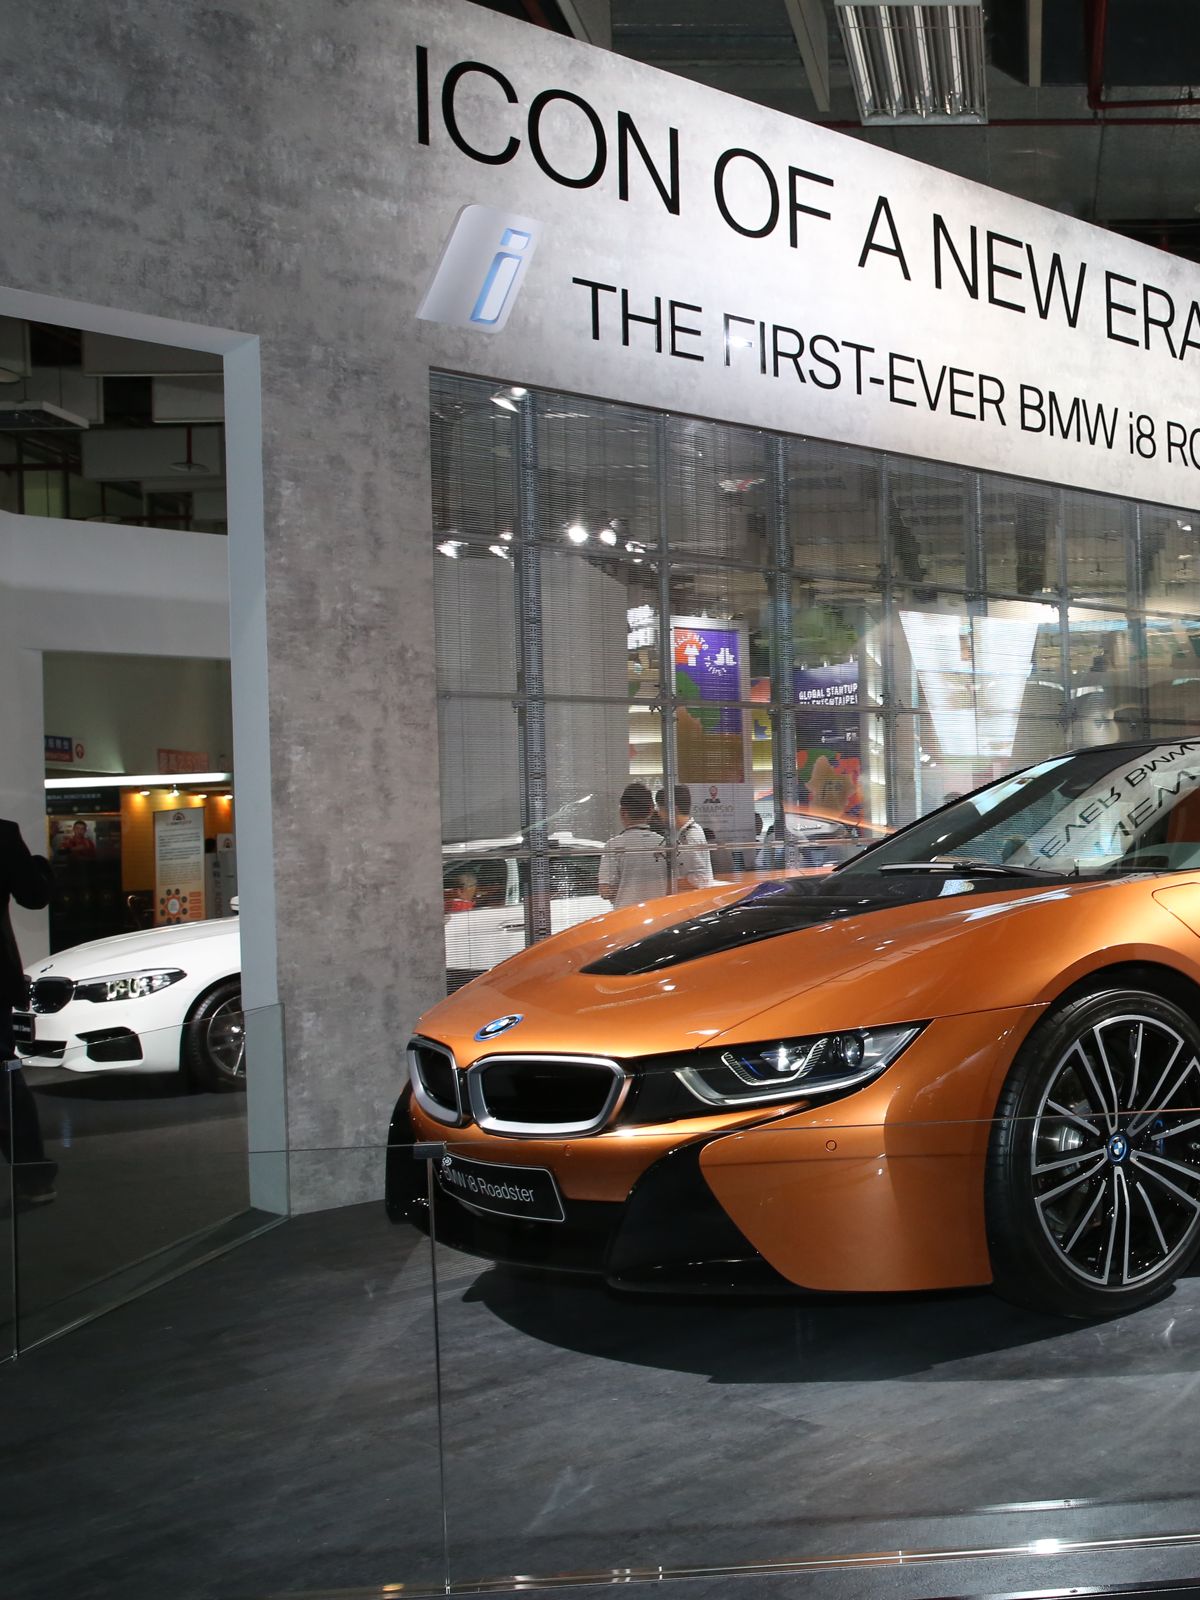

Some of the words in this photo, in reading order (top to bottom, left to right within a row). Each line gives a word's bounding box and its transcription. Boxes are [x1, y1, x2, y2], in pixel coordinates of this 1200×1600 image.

[416, 45, 681, 216] ICON
[714, 148, 834, 249] OF
[857, 195, 911, 281] A
[933, 213, 1087, 328] NEW
[572, 276, 704, 362] THE
[723, 313, 1006, 426] FIRST-EVER
[1020, 385, 1118, 449] BMW
[1128, 411, 1156, 459] i8
[799, 687, 825, 700] GLOBAL
[826, 683, 858, 697] STARTUP
[477, 1177, 535, 1203] Roadster
